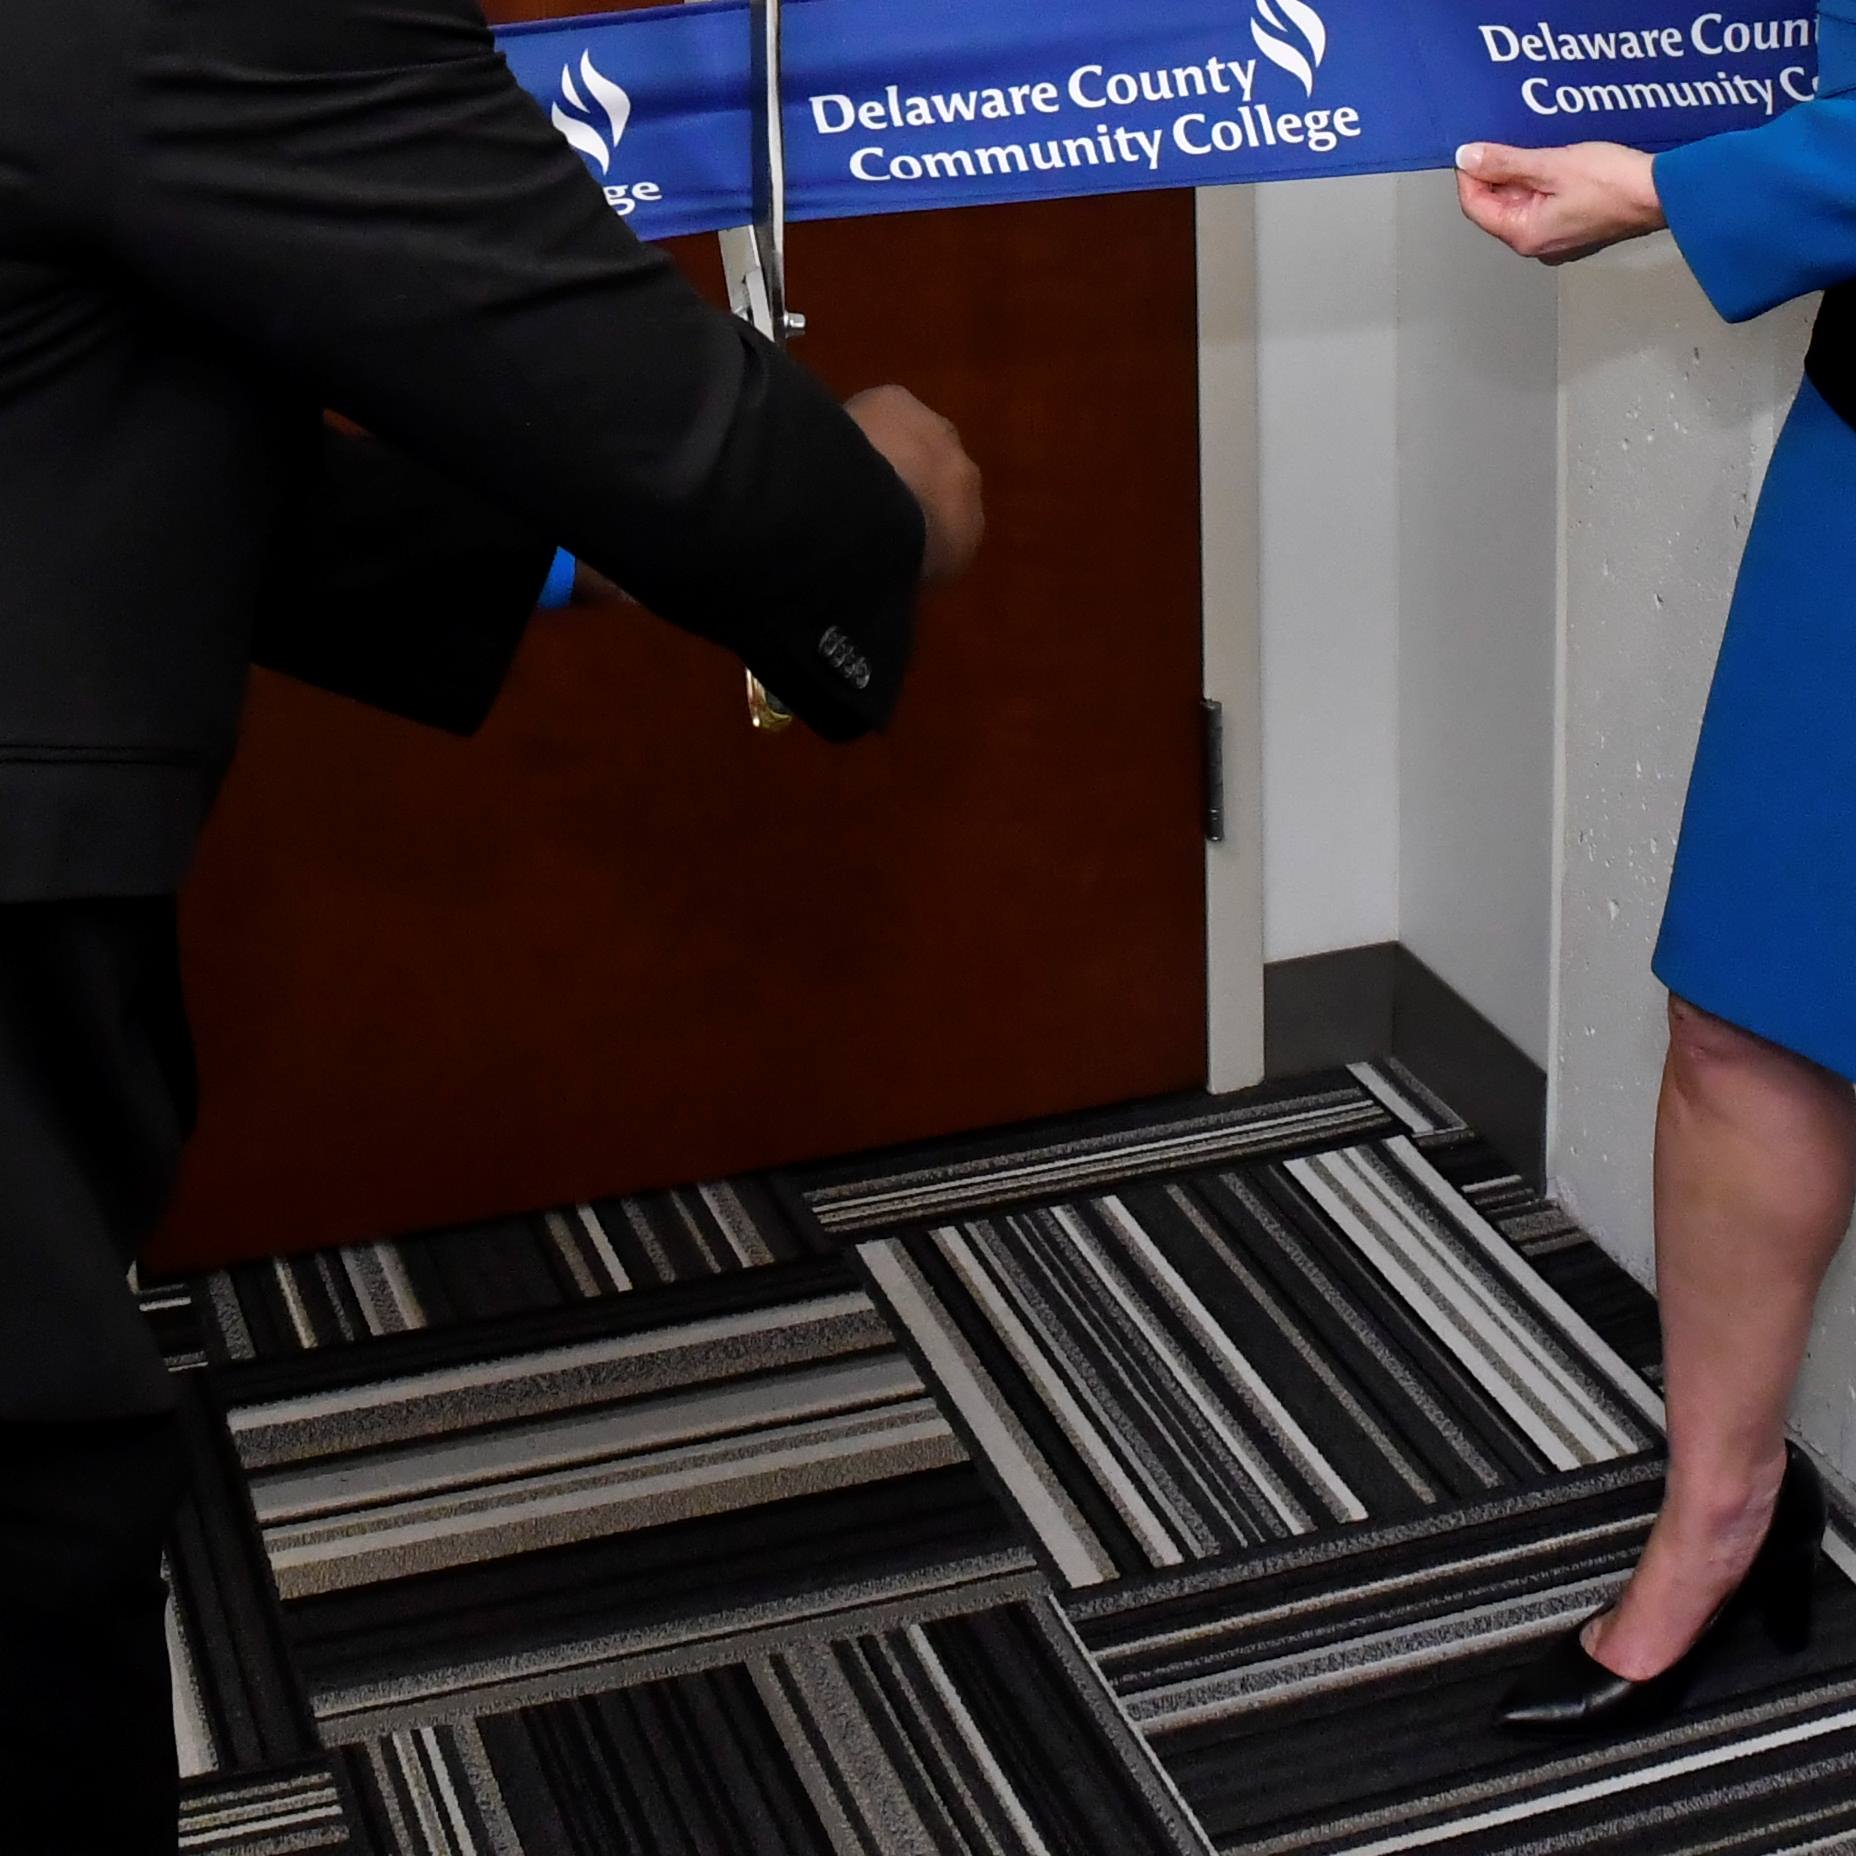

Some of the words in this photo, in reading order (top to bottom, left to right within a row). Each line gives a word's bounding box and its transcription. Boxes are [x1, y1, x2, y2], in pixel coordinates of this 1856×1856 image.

[1478, 22, 1684, 63] Delaware
[809, 81, 1060, 136] Delaware
[1067, 56, 1256, 109] County
[1521, 70, 1774, 116] Community
[849, 123, 1162, 183] Community
[1172, 103, 1361, 155] College
